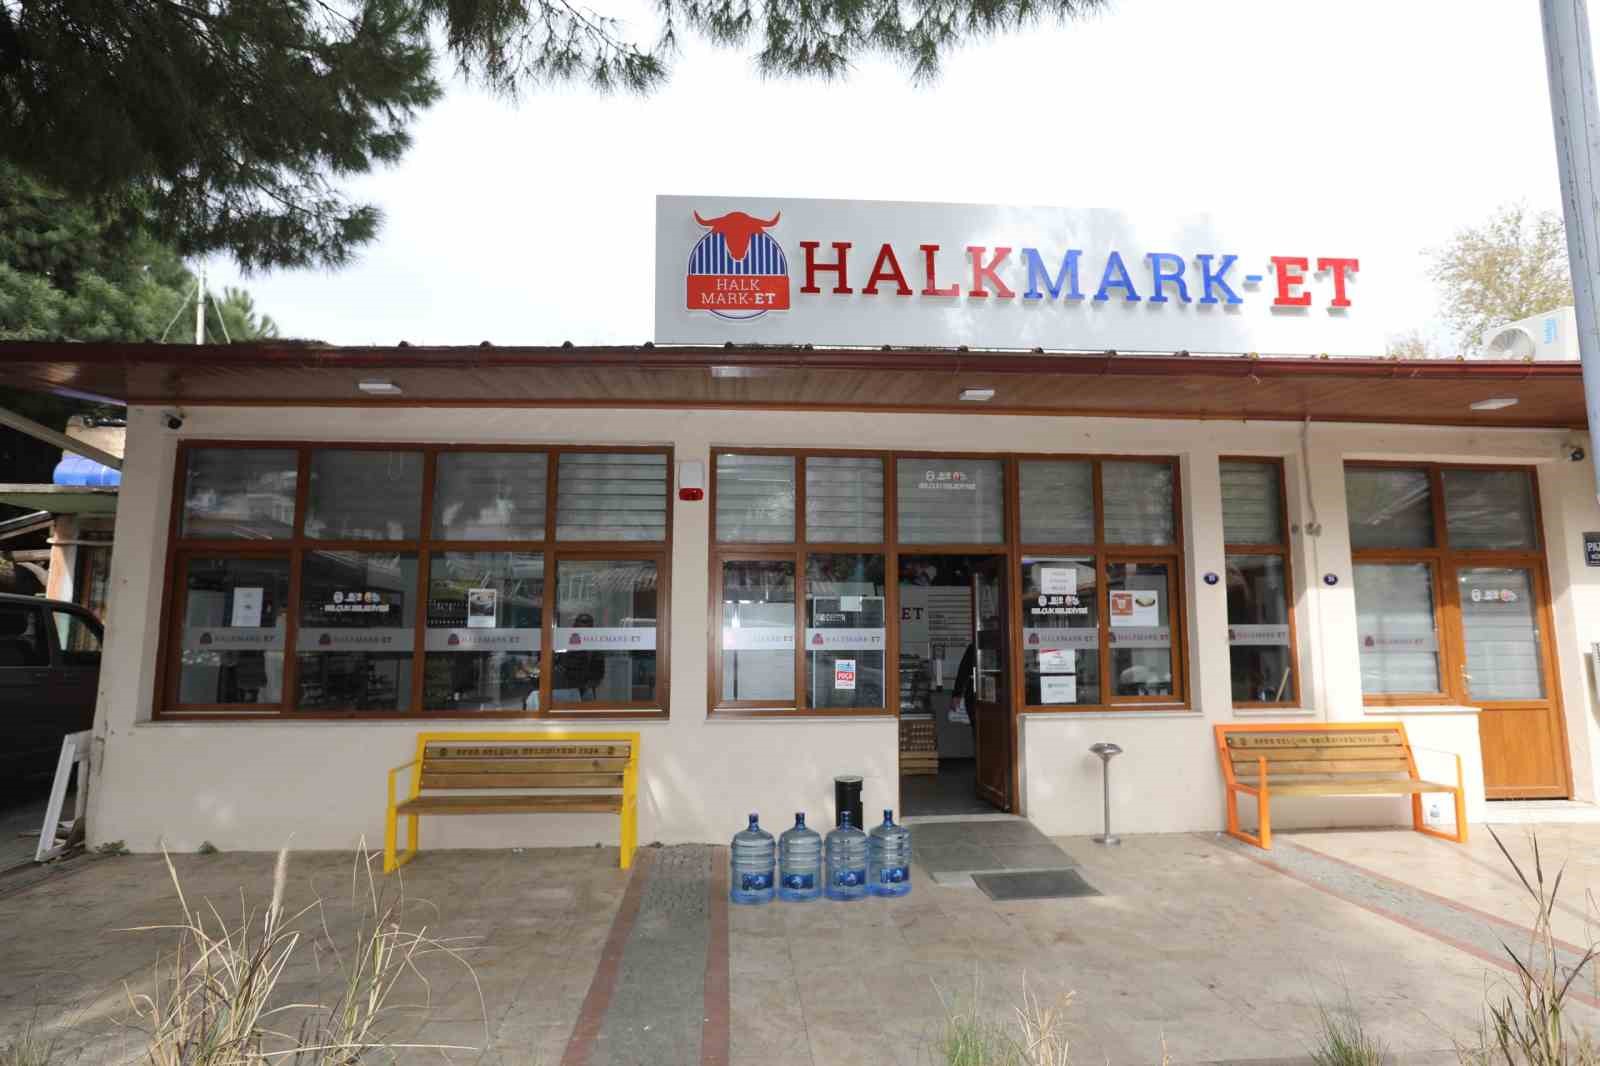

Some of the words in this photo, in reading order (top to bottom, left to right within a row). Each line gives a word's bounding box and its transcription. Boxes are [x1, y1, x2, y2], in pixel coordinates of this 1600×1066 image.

[799, 241, 1360, 308] HALKMARK-ET
[716, 278, 761, 291] HALK
[701, 292, 776, 305] MARK-ET
